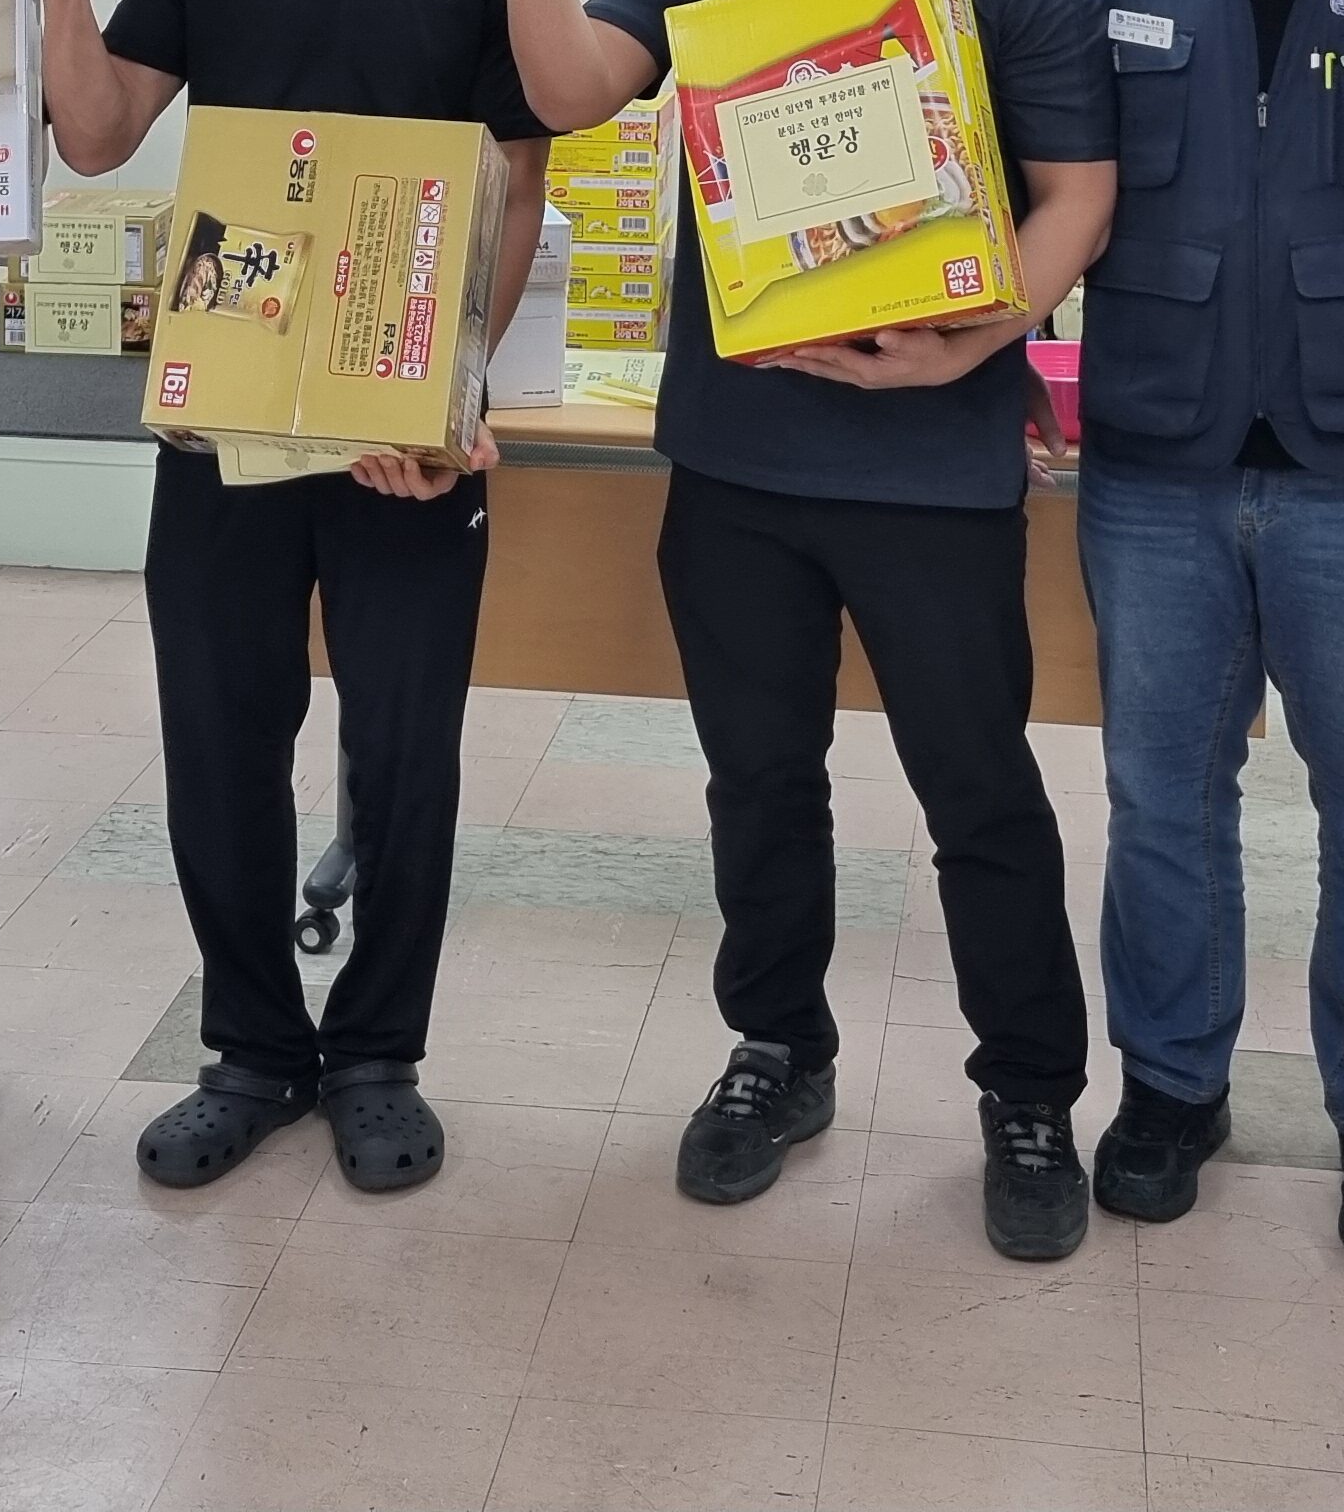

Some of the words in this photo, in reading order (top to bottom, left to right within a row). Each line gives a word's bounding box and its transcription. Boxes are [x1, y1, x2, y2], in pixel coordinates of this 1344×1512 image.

[743, 107, 780, 125] 2026년
[785, 98, 813, 115] 임단협
[871, 78, 891, 92] 위한
[778, 122, 805, 138] 분임조
[789, 126, 859, 165] 행운상
[287, 158, 308, 202] 농심
[59, 241, 94, 253] 행운상
[222, 242, 281, 288] 辛
[335, 254, 349, 293] 주의사항
[946, 258, 977, 279] 20입
[216, 270, 231, 304] GOLD
[228, 278, 243, 306] 라면
[949, 277, 981, 295] 박스
[379, 322, 397, 356] 농심
[410, 298, 427, 362] 080-023-5181
